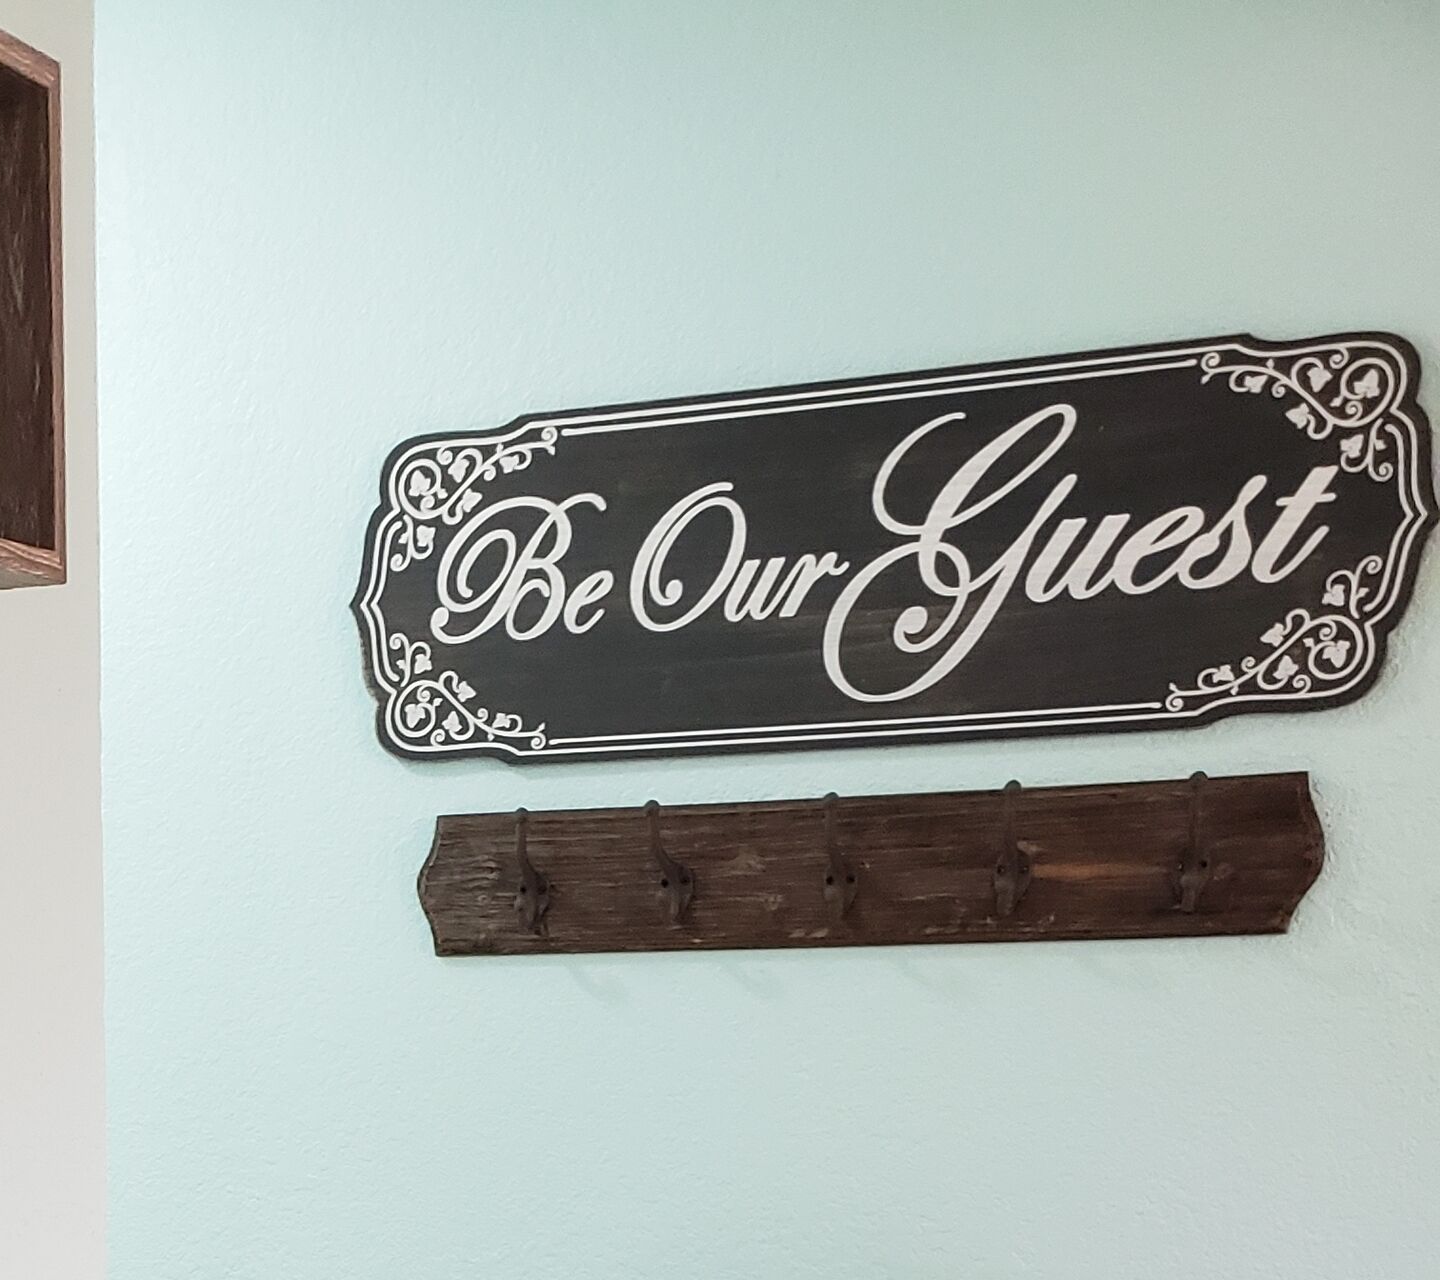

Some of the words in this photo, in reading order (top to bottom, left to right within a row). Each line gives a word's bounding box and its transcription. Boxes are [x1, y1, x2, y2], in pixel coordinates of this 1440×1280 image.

[429, 492, 615, 646] Be
[628, 481, 850, 634] Our
[822, 403, 1339, 704] Guest
